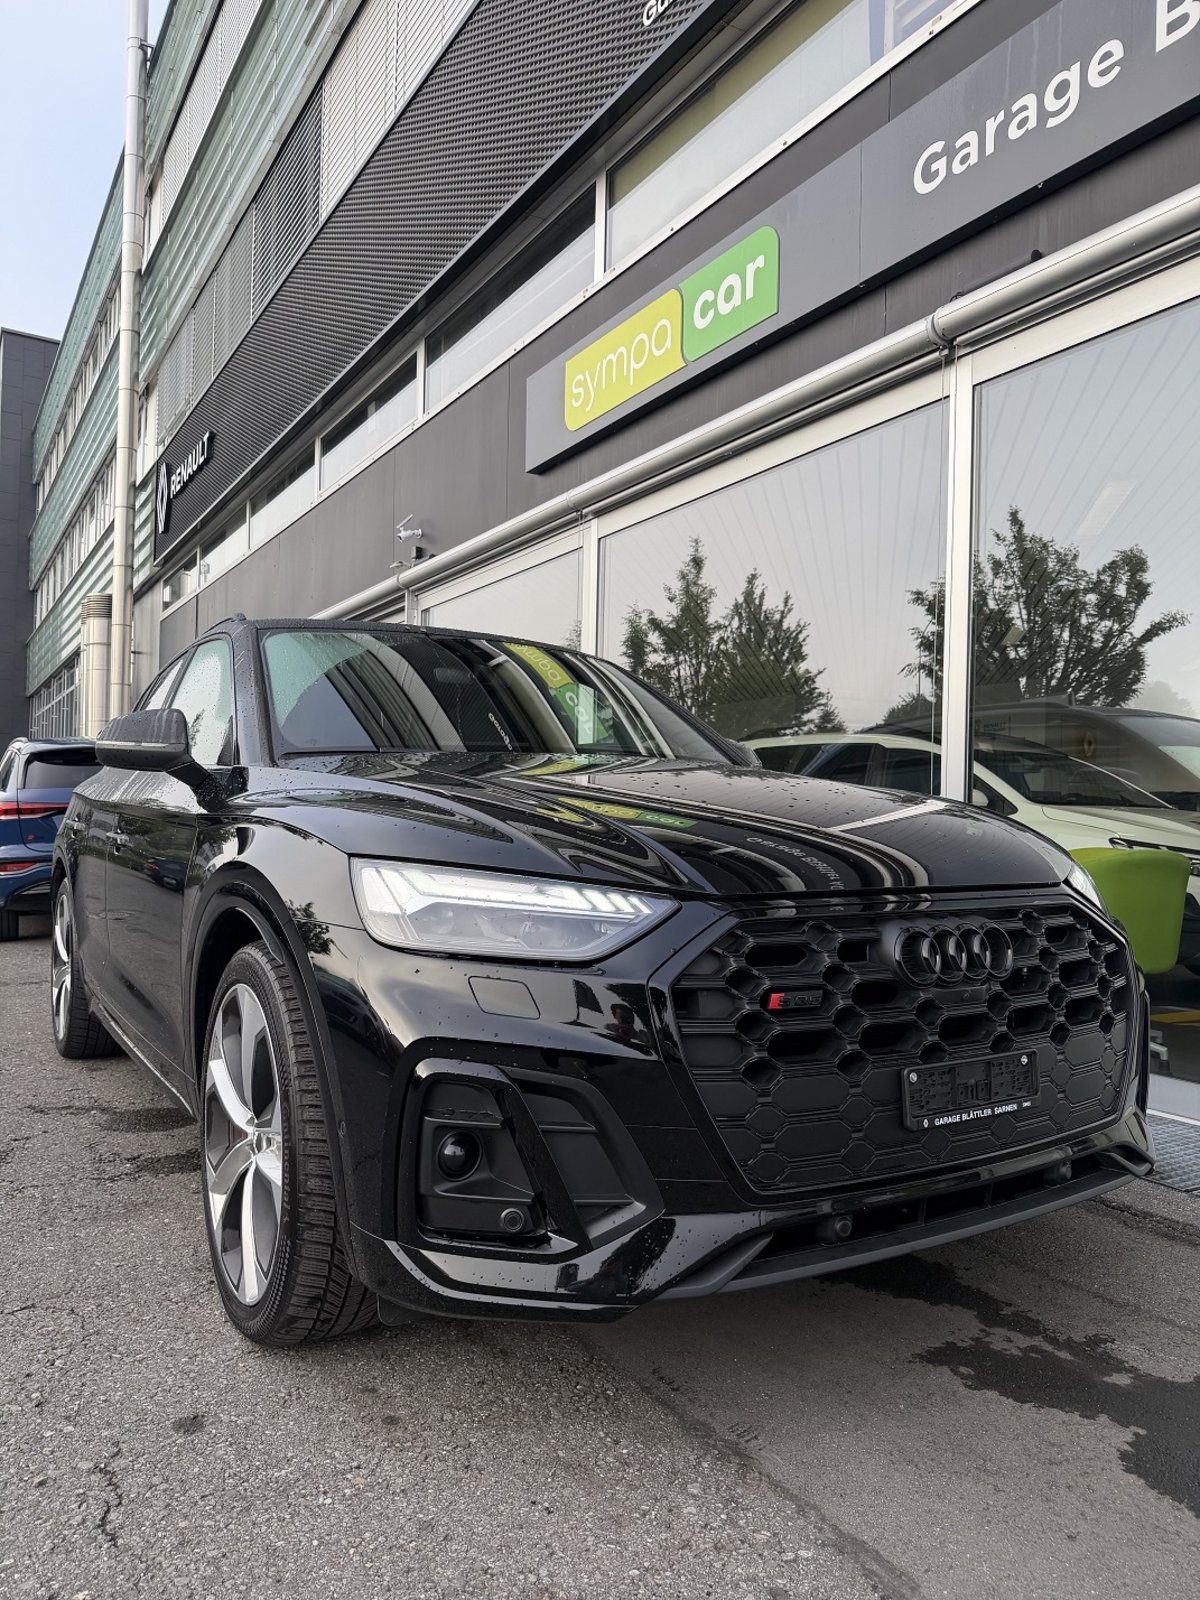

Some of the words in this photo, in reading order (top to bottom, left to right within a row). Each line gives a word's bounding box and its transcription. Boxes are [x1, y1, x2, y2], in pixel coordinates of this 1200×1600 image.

[913, 38, 1125, 195] Garage
[571, 318, 672, 413] sympa
[693, 254, 765, 329] car
[170, 431, 210, 499] RENAULT
[934, 1114, 961, 1126] GARAGE
[994, 1103, 1018, 1115] SARNEN
